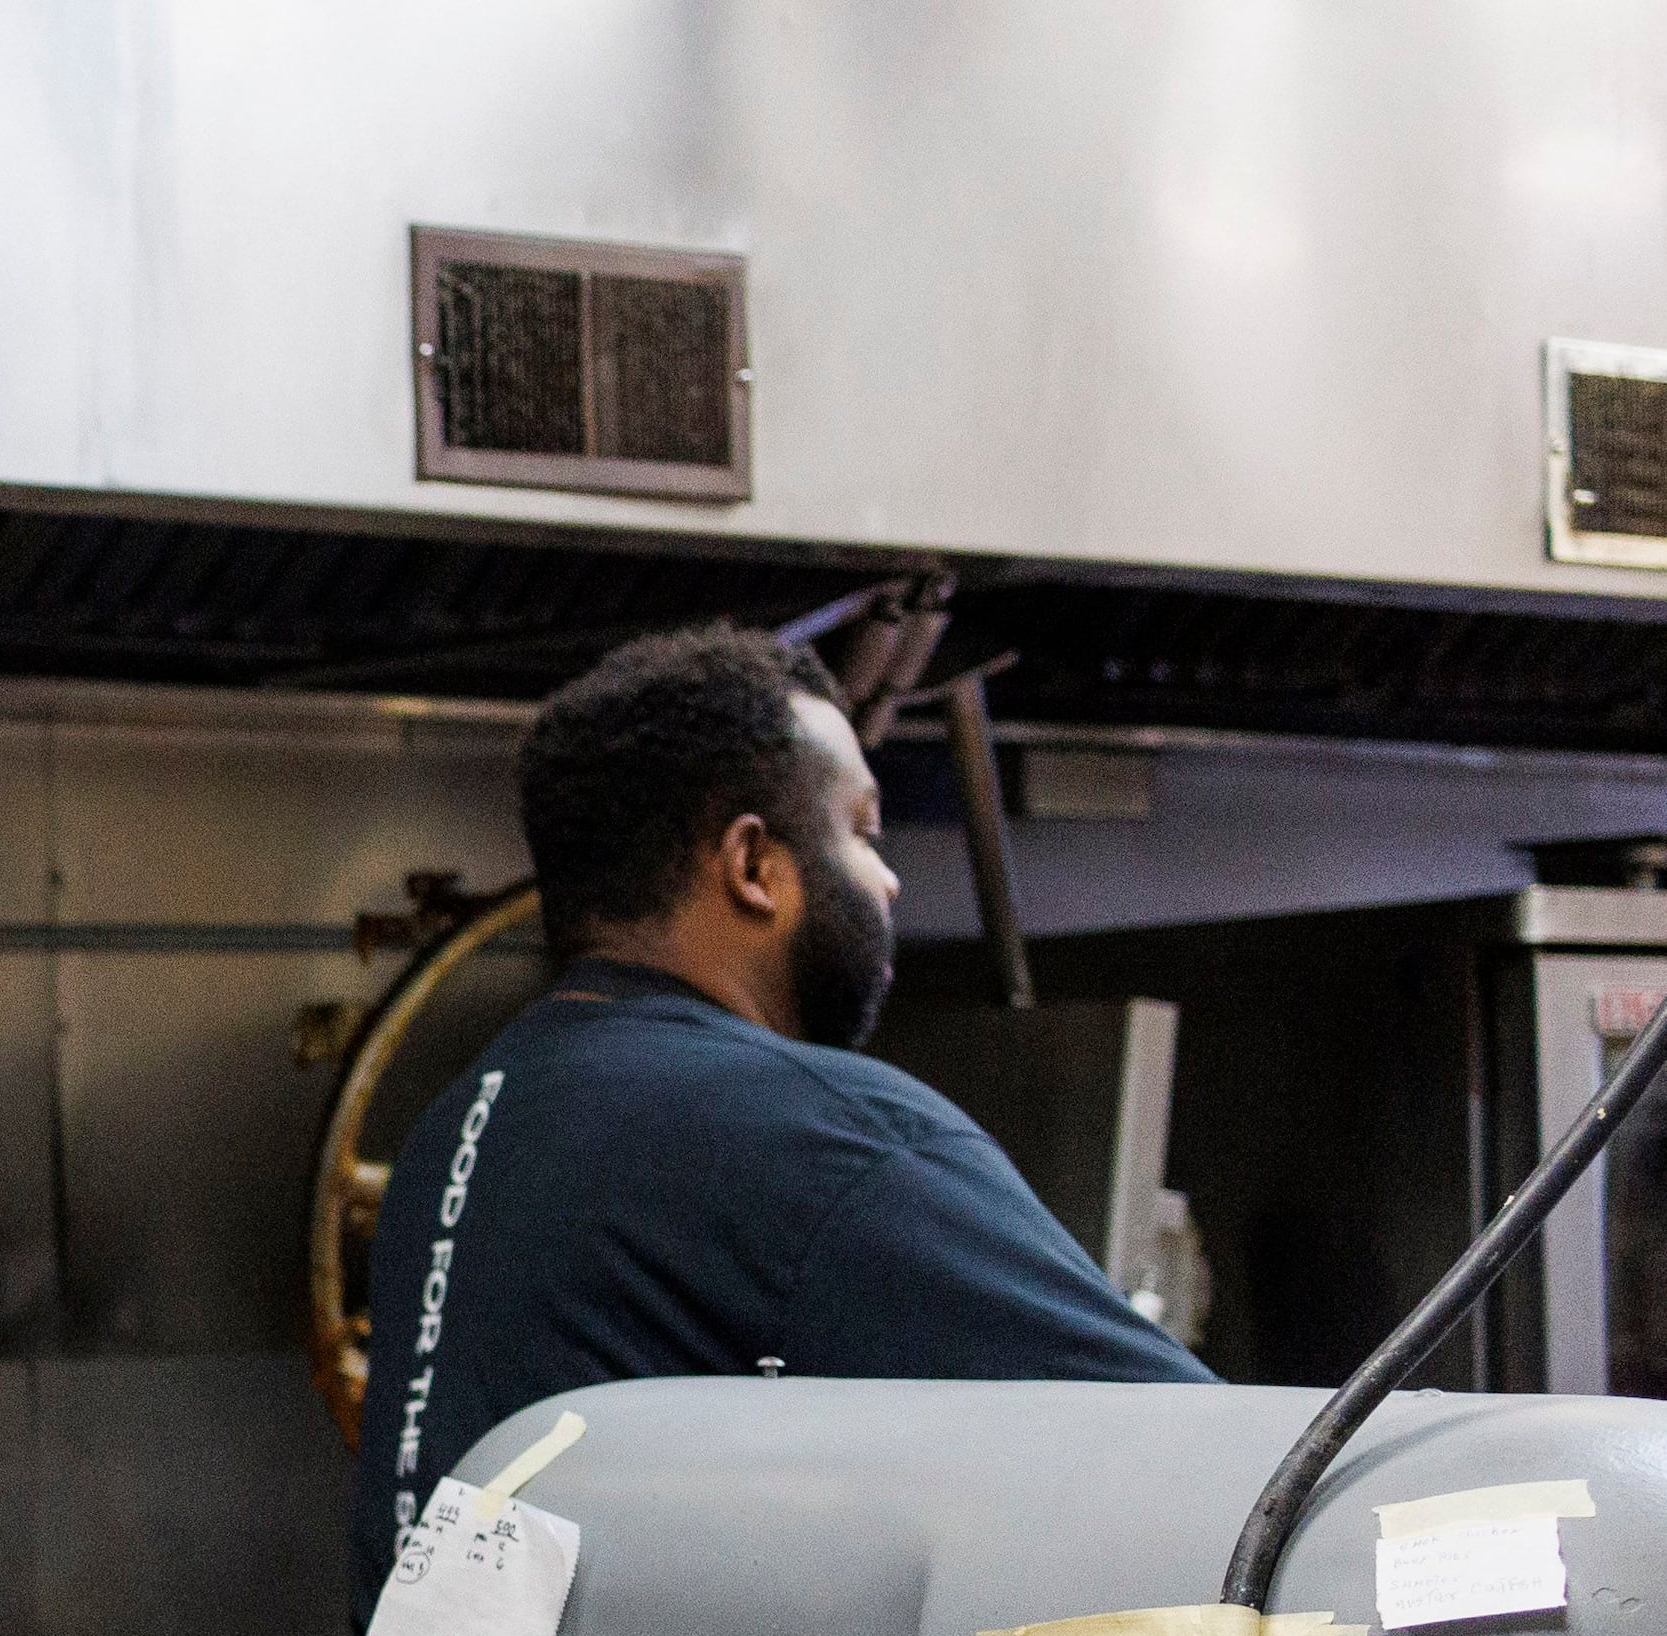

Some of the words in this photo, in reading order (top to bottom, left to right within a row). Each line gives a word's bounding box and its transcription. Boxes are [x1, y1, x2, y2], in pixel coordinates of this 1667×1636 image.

[440, 1070, 506, 1228] FOOD
[415, 1239, 454, 1356] FOR
[396, 1366, 434, 1478] THE
